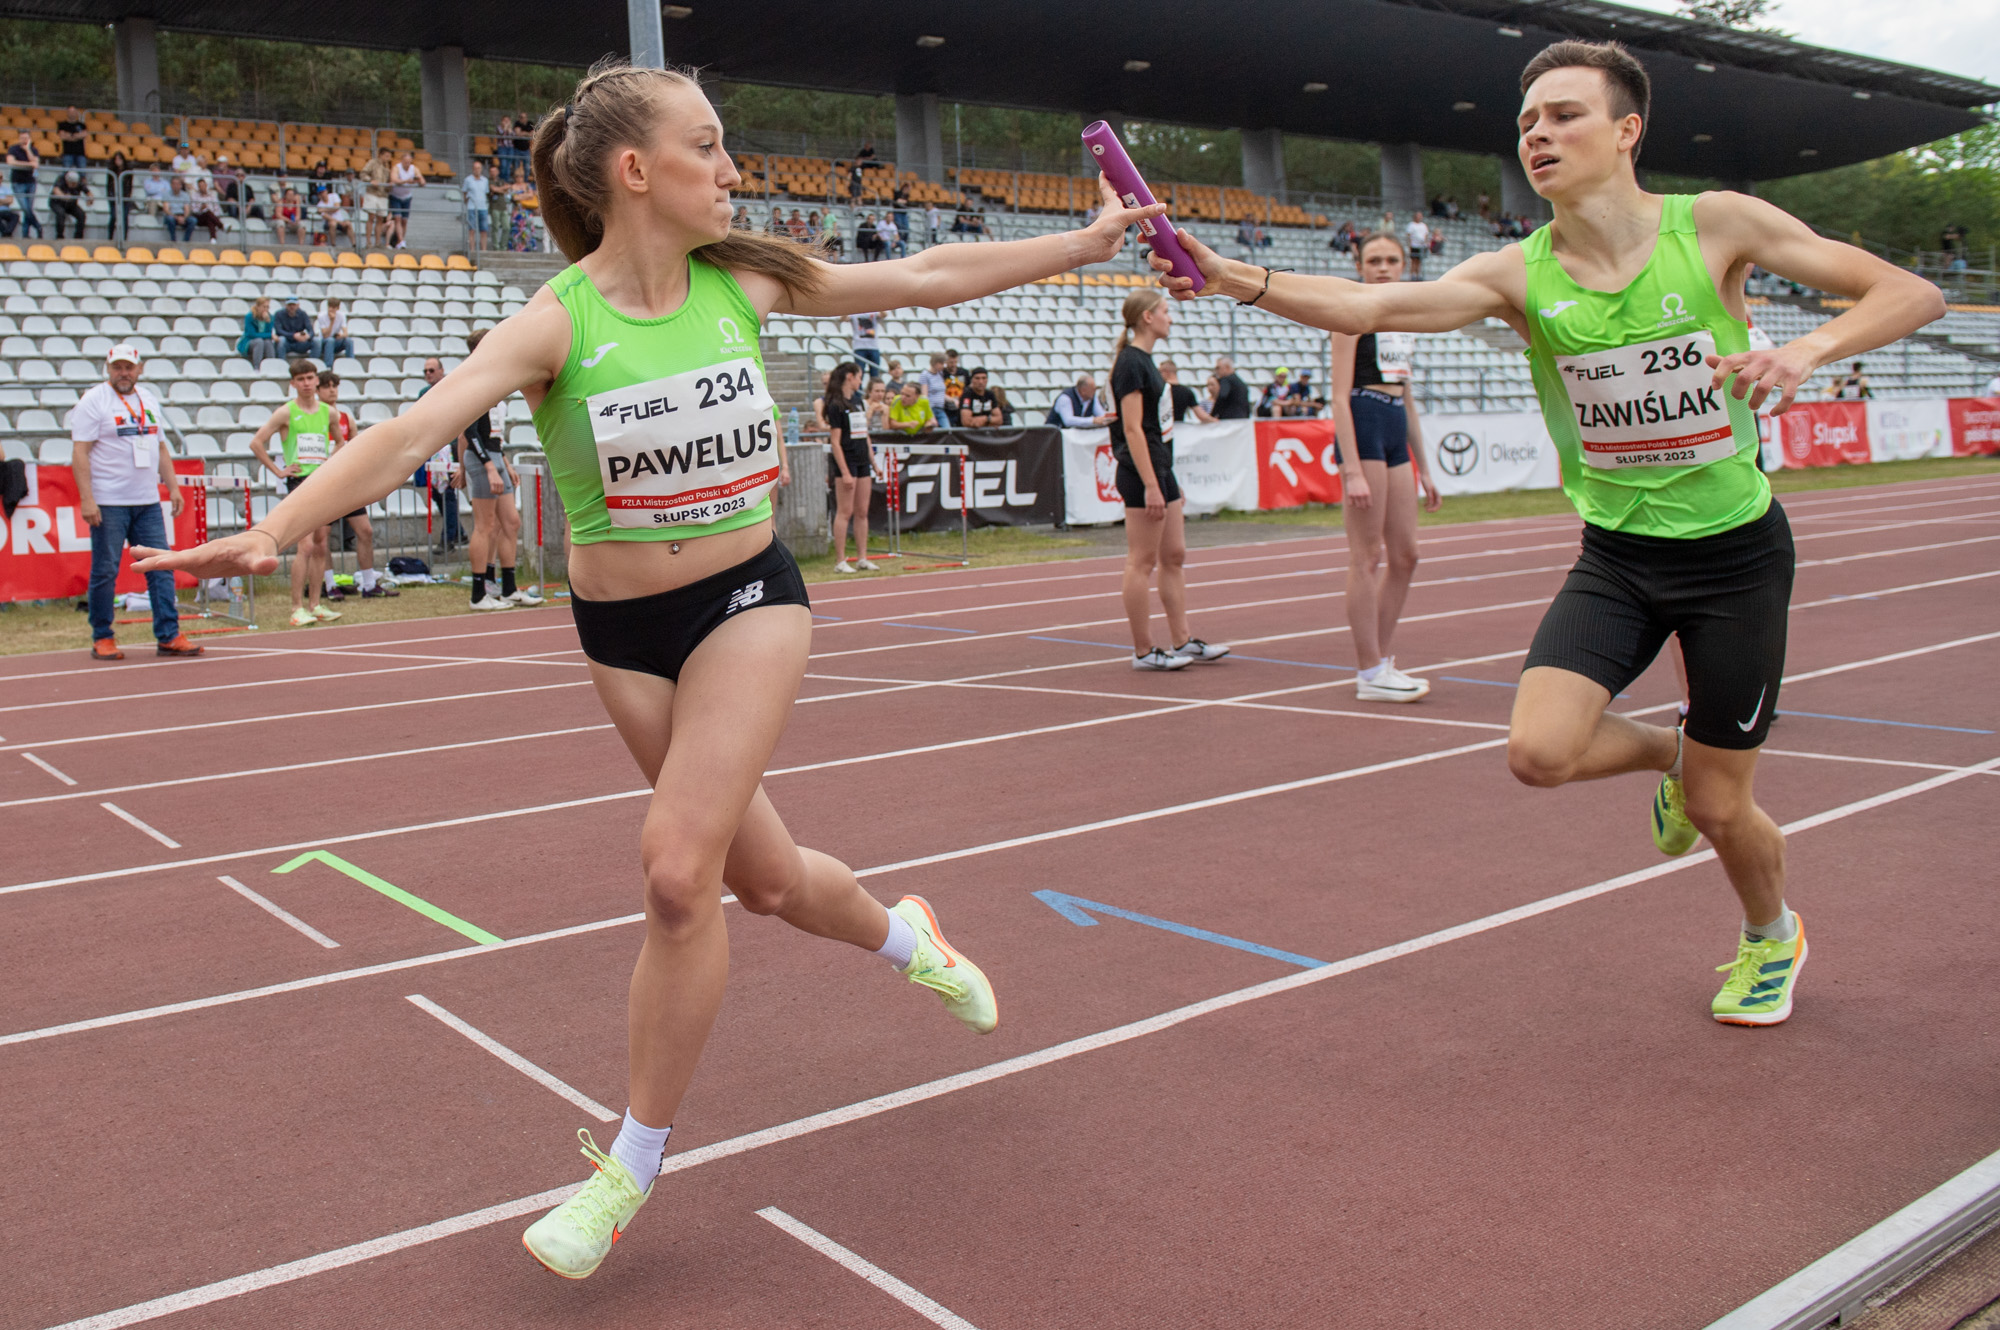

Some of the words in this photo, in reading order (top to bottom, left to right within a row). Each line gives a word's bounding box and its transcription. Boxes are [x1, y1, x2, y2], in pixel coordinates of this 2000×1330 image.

[1657, 314, 1696, 329] Kleszczów
[1640, 341, 1703, 375] 236
[695, 367, 754, 409] 234
[1574, 385, 1721, 428] ZAWIŚLAK
[607, 419, 772, 482] PAWELUS
[1490, 442, 1538, 464] Okęcie
[1605, 442, 1647, 450] Mistrzostwa
[1647, 440, 1669, 448] Polski
[1678, 431, 1721, 446] Sztafetach
[1615, 453, 1662, 465] SŁUPSK
[1663, 449, 1697, 462] 2023
[621, 498, 642, 507] PZLA
[643, 494, 694, 507] Mistrzostwa
[695, 488, 721, 500] Polski
[722, 487, 730, 495] w
[730, 473, 769, 493] Sztafetach
[906, 459, 1038, 513] FUEL
[653, 506, 711, 523] SŁUPSK
[713, 496, 746, 516] 2023
